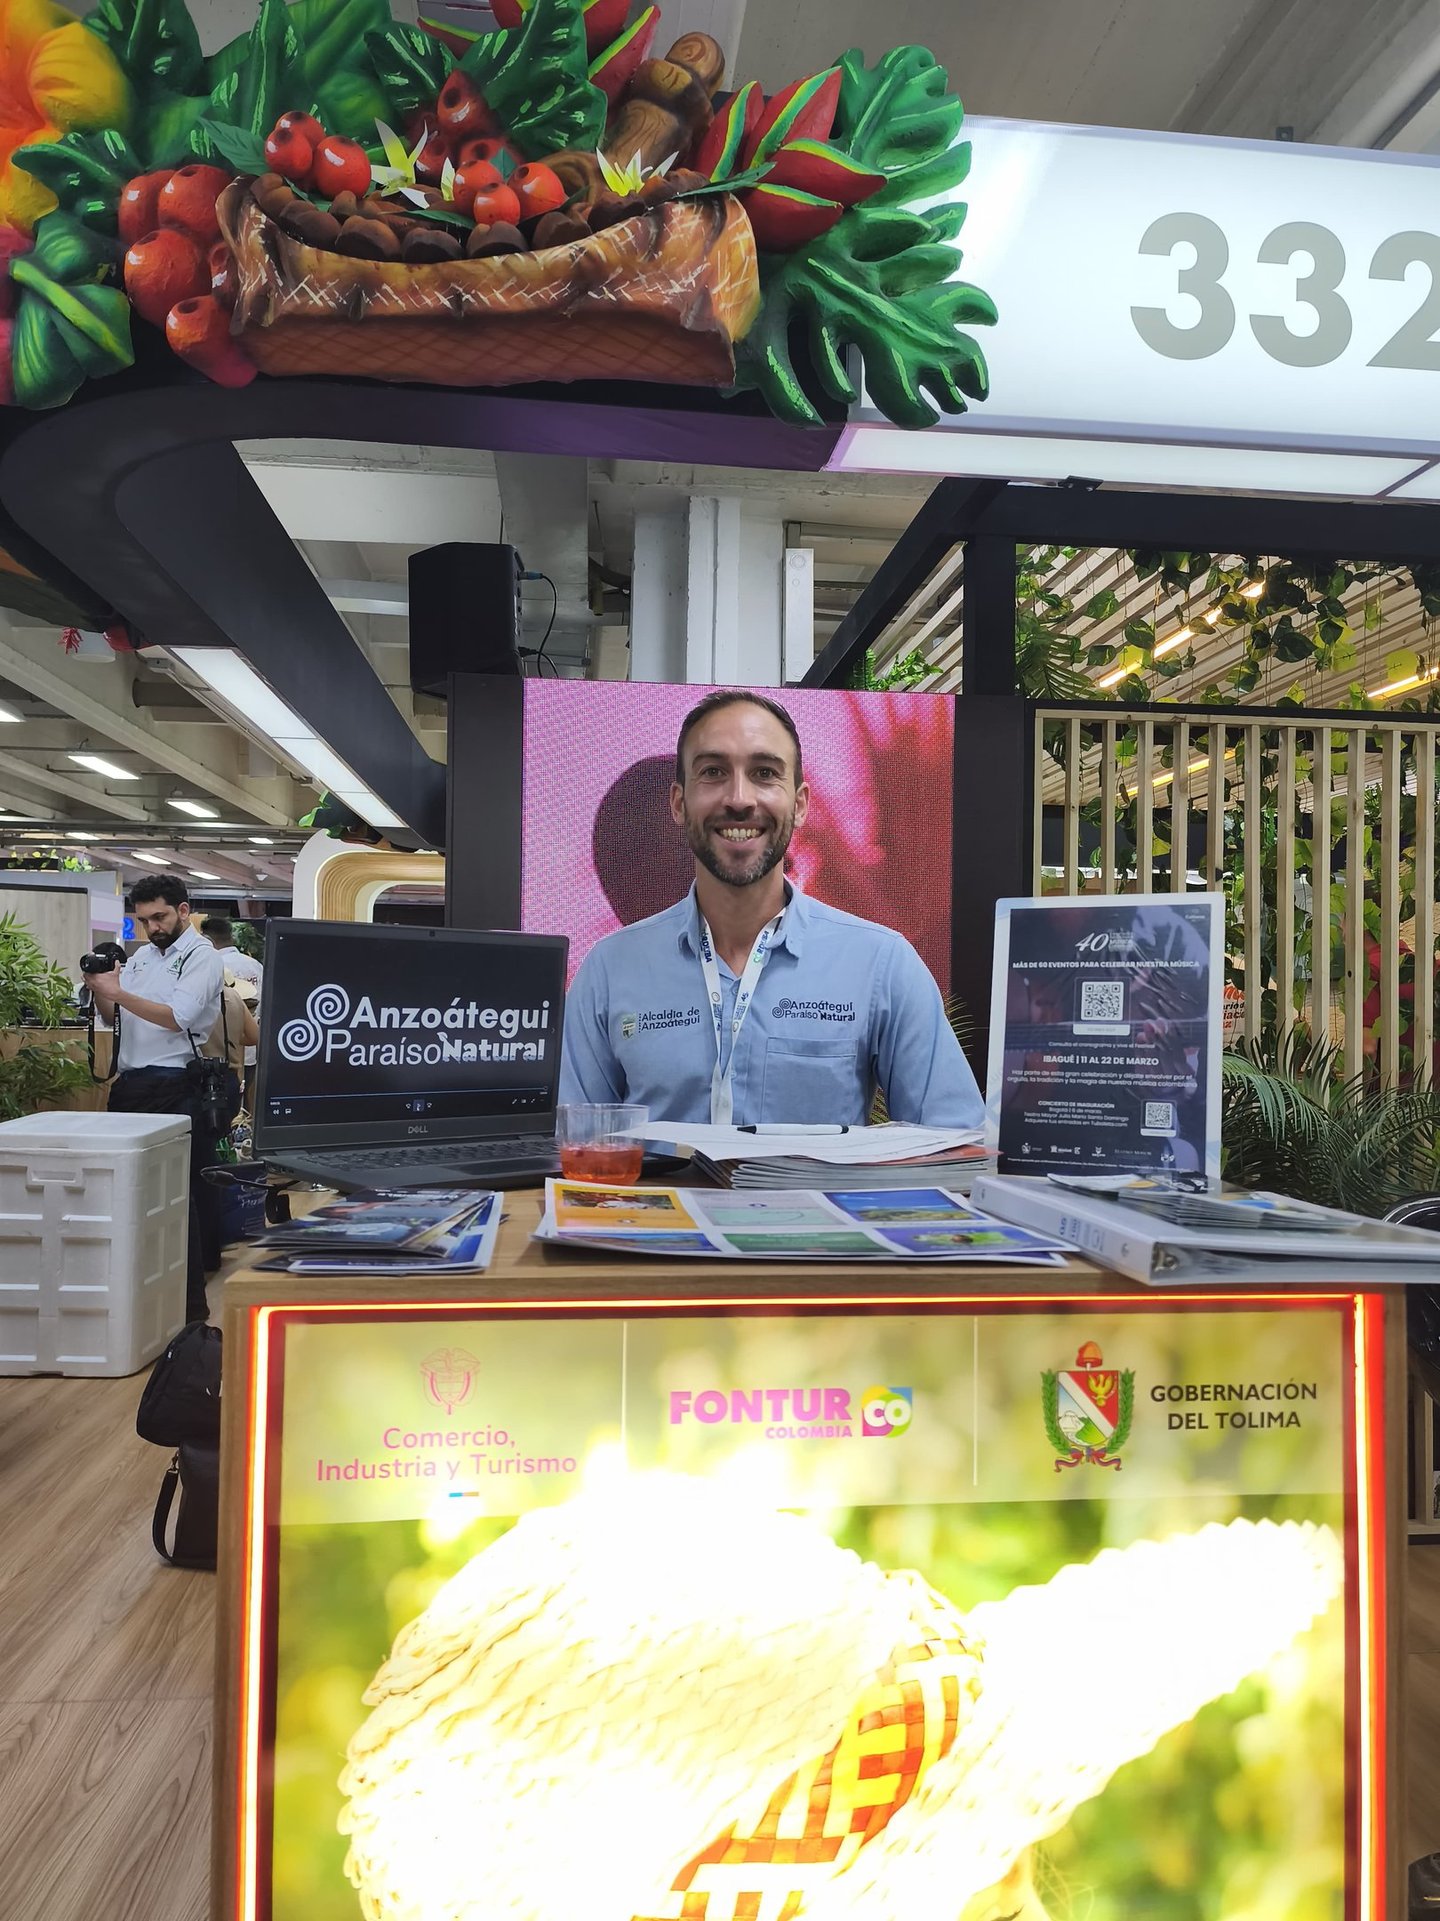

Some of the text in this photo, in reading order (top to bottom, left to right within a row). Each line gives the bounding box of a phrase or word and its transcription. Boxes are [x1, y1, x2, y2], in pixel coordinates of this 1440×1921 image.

[1130, 211, 1440, 371] 332
[1075, 933, 1109, 951] 40
[1012, 960, 1028, 968] MÁS
[1170, 959, 1200, 967] MÚSICA
[687, 1006, 700, 1017] de
[790, 1000, 853, 1014] Anzoátegui
[820, 1010, 856, 1021] Natural
[349, 996, 550, 1039] Anzoátegui
[641, 1014, 700, 1031] Anzoátegui
[325, 1029, 441, 1066] Paraíso
[1043, 1053, 1075, 1063] IBAGUÉ
[1089, 1056, 1100, 1064] AL
[1101, 1056, 1112, 1064] 22
[1126, 1057, 1159, 1066] MARZO
[407, 1125, 428, 1135] DELL
[1150, 1377, 1317, 1403] GOBERNACIÓN
[669, 1387, 912, 1427] FONTUR CO
[1167, 1410, 1301, 1431] DEL TOLIMA
[382, 1424, 517, 1450] Comercio,
[765, 1422, 853, 1439] COLOMBIA
[315, 1452, 577, 1481] Industria y Turismo
